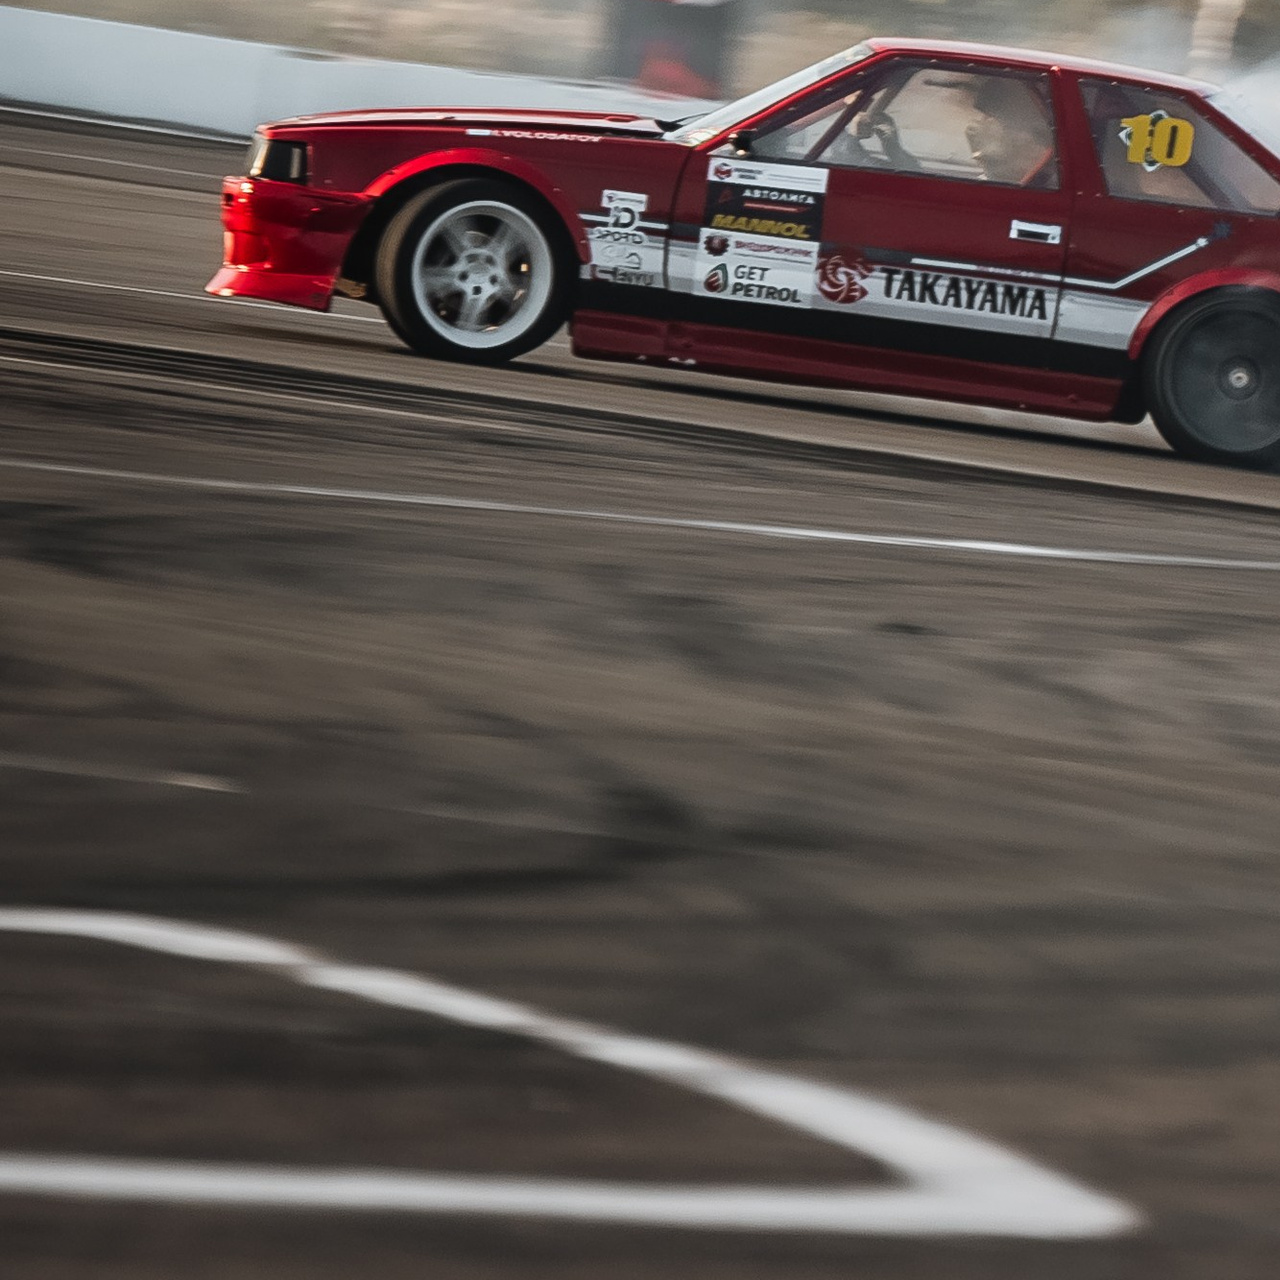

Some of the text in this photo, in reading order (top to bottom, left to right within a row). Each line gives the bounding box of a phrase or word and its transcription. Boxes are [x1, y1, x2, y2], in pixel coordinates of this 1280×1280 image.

[1120, 114, 1195, 167] 10
[710, 214, 811, 239] MANNOL
[734, 264, 771, 281] GET
[731, 282, 802, 303] PETROL
[880, 266, 1047, 320] TAKAYAMA
